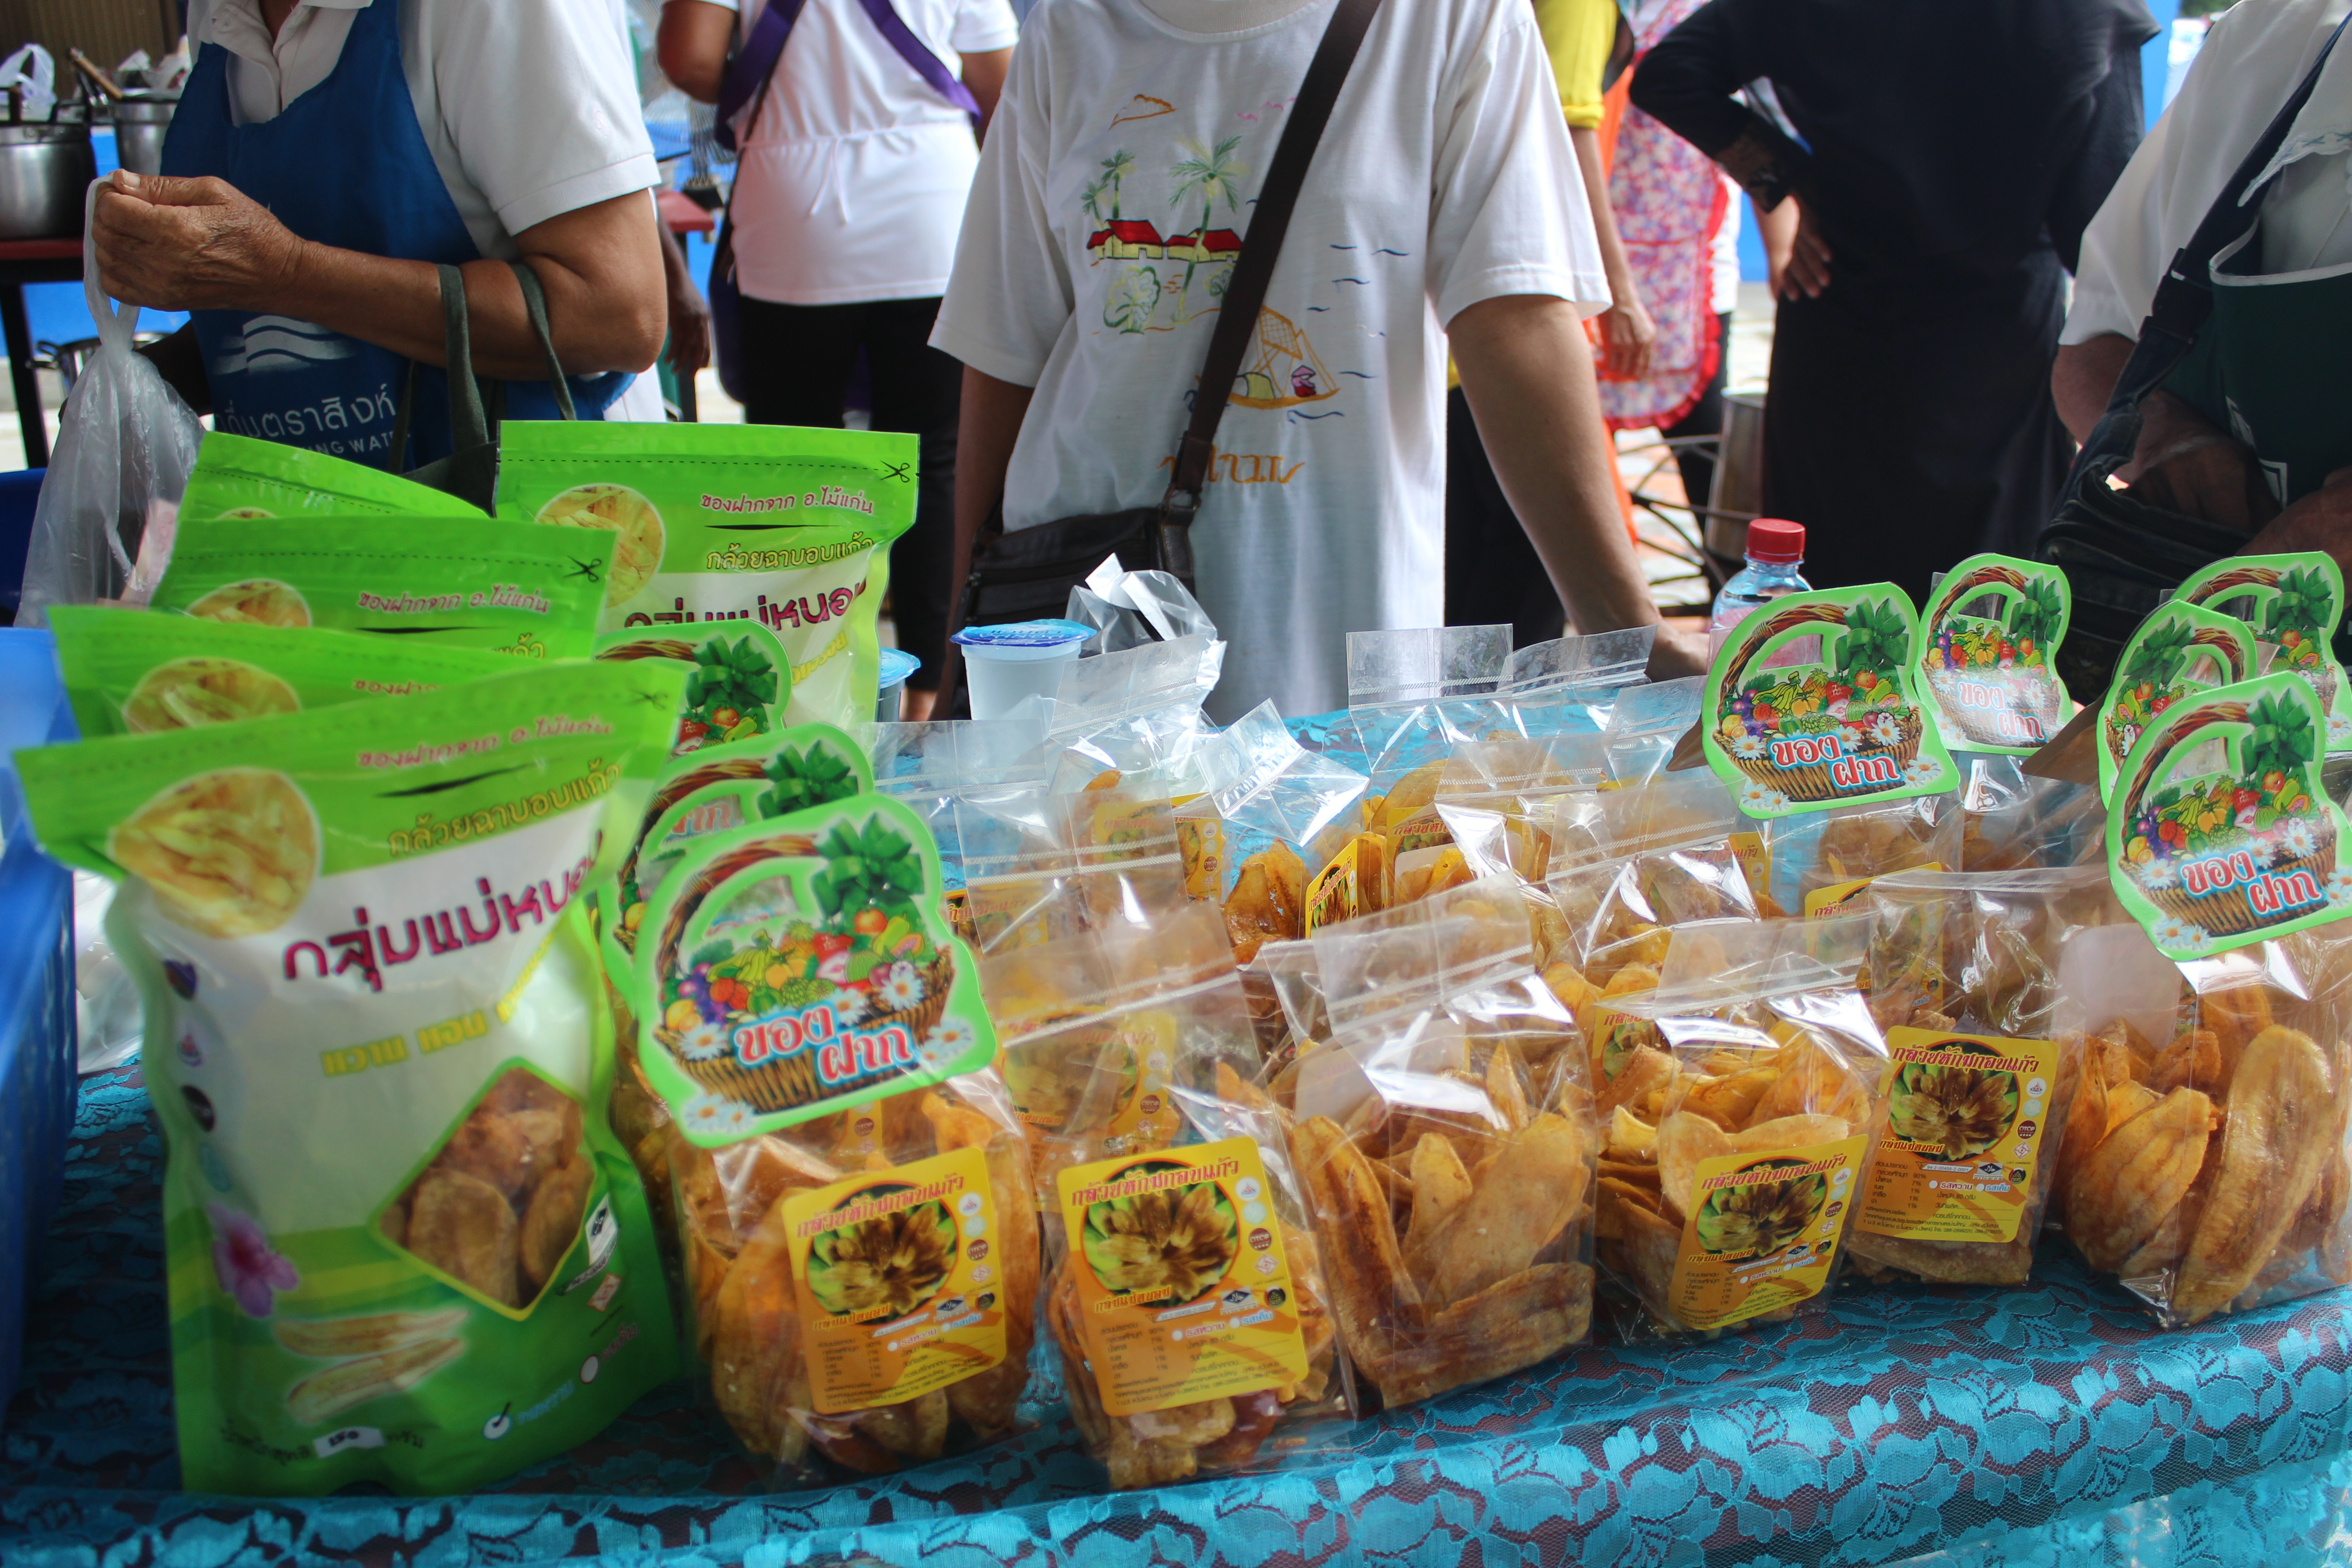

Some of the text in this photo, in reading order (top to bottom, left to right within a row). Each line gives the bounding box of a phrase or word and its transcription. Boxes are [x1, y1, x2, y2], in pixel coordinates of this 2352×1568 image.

[701, 486, 873, 514] ของฝากจาก อ.ไม้แก่น
[358, 592, 461, 613] ของฝากจาก
[1959, 681, 2005, 710] ของ
[1997, 708, 2046, 740] ฝาก
[1771, 734, 1842, 767] ของ
[1831, 755, 1901, 788] ฝาก
[388, 758, 621, 857] กล้วยฉาบอบแก้ว
[2180, 850, 2258, 896] ของ
[2247, 870, 2322, 916] ฝาก
[734, 1005, 835, 1063] ของ
[818, 1026, 914, 1084] ฝาก
[1892, 1044, 2039, 1073] กล้วยหักมุกอบแก้ว
[1879, 1138, 1944, 1153] กลุ่มแม่หนอม
[1940, 1182, 2010, 1192] รสหวาน รสเค็ม
